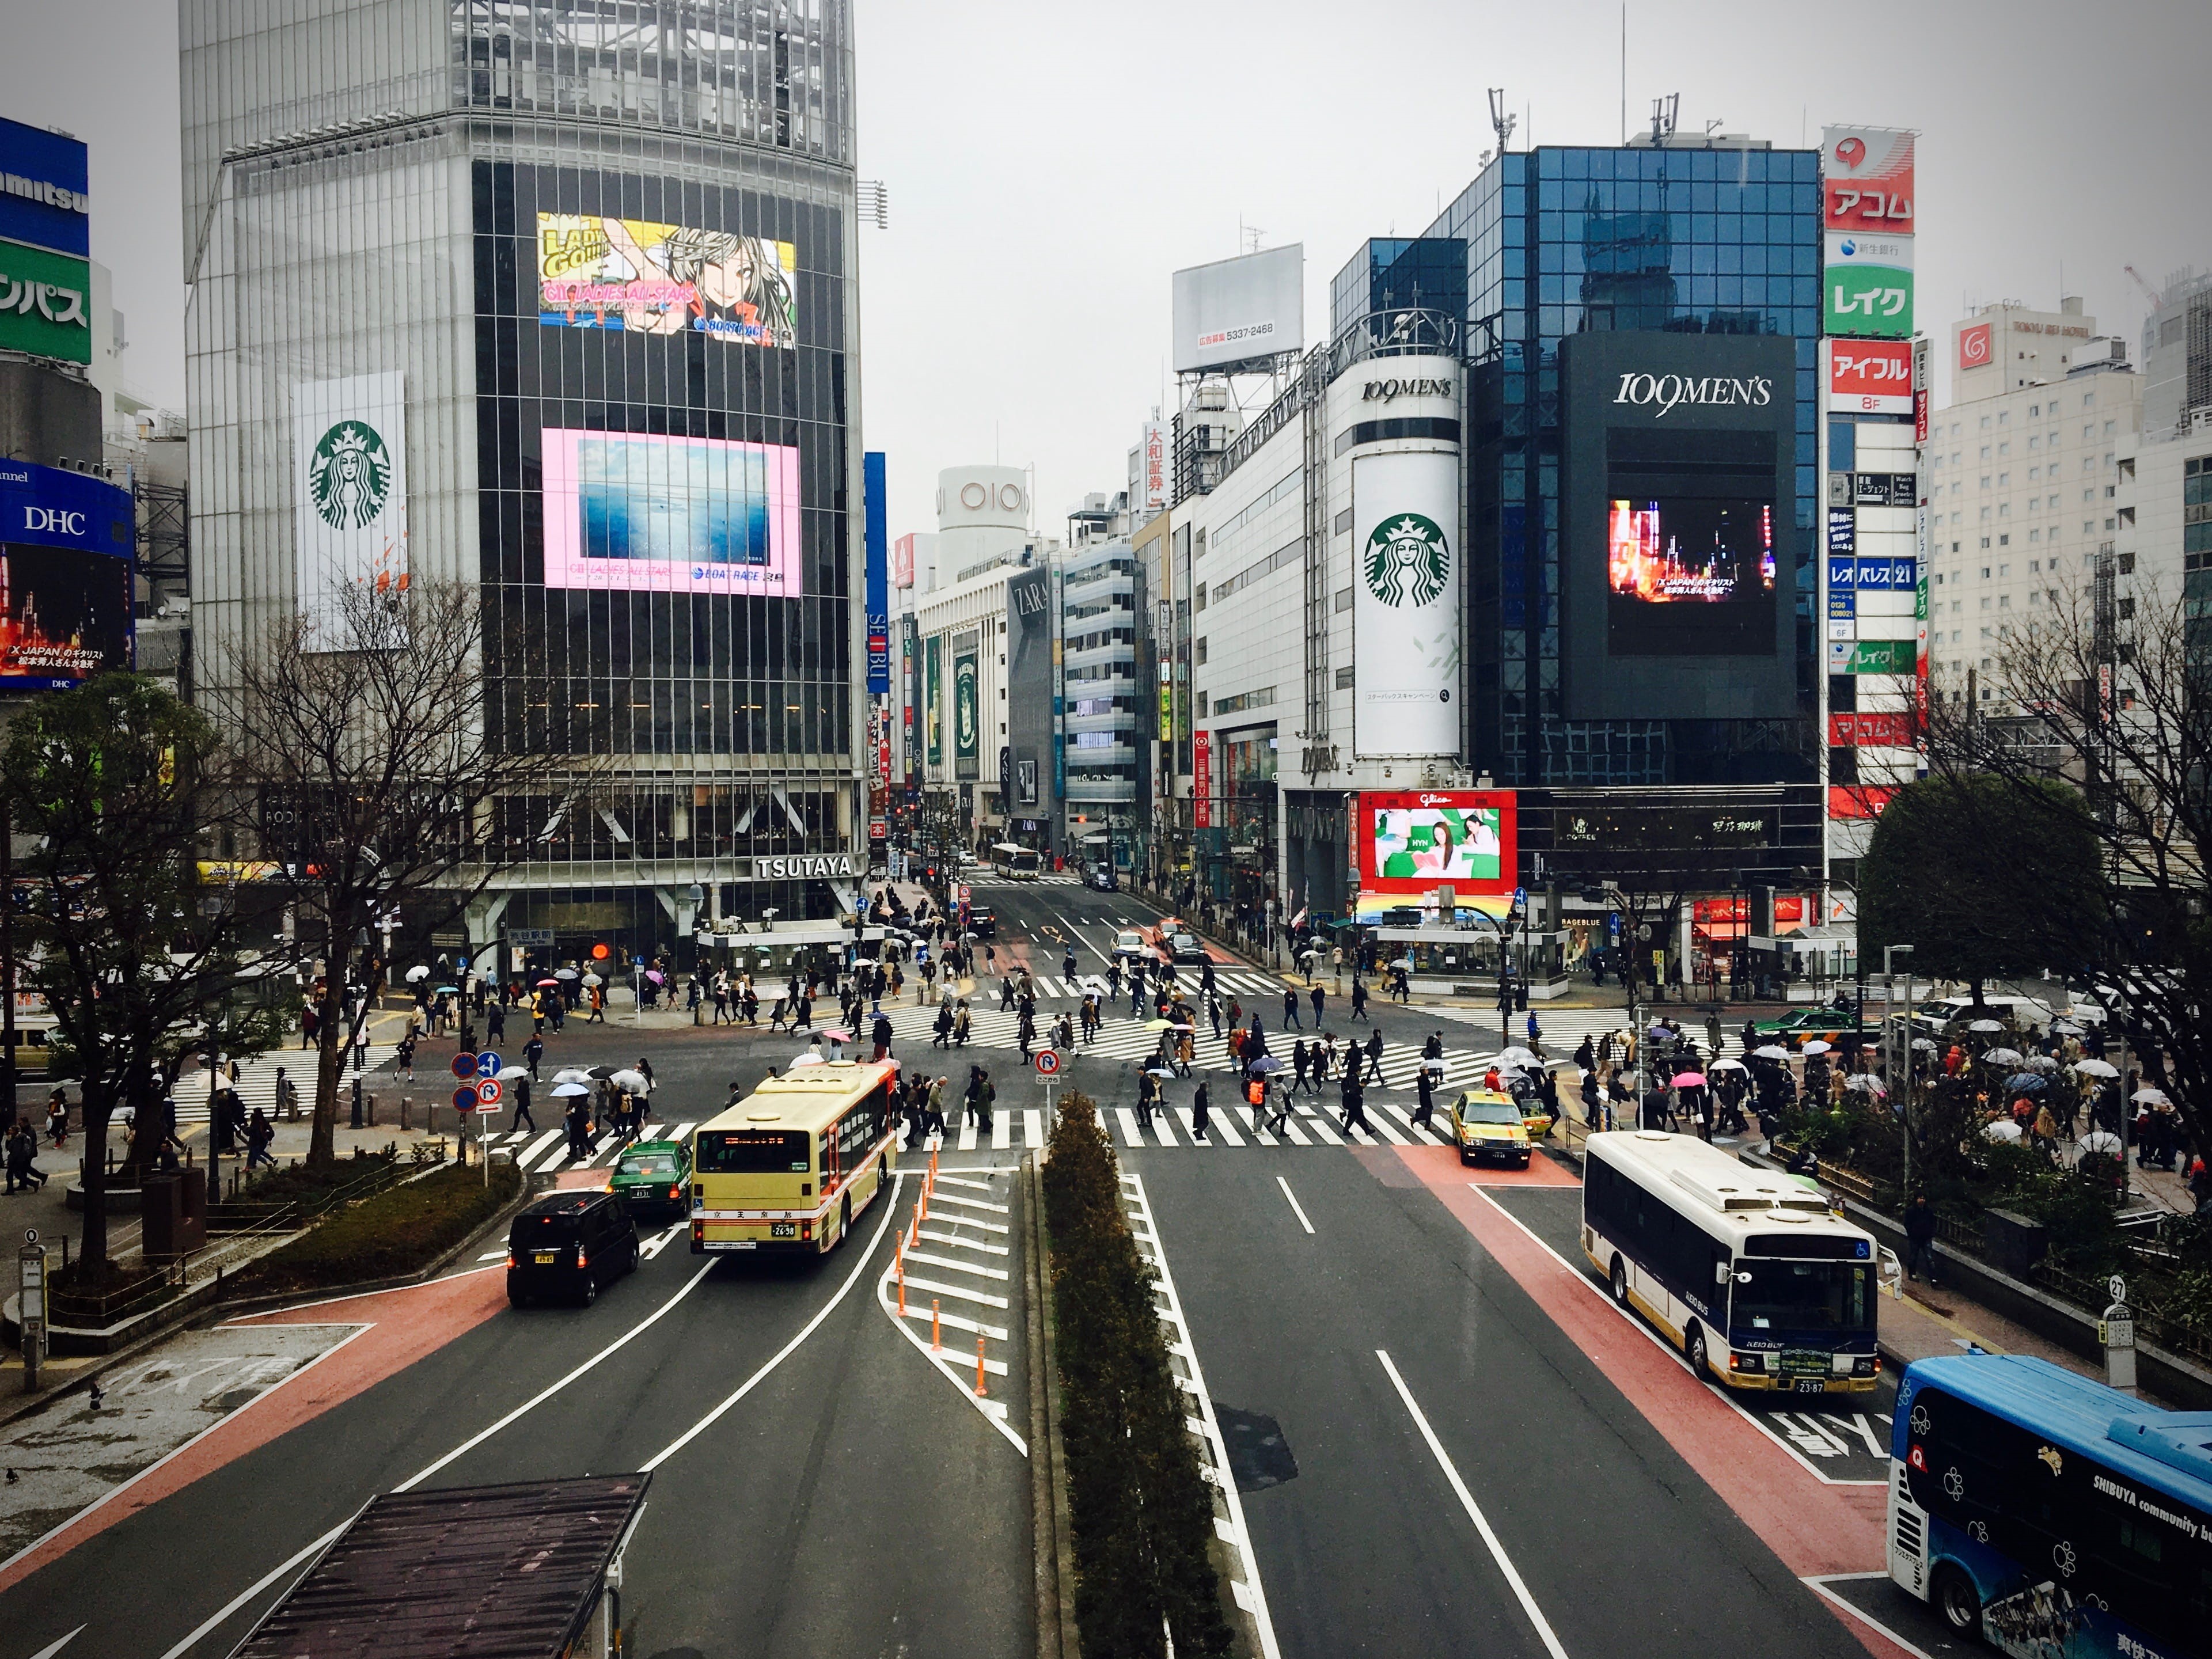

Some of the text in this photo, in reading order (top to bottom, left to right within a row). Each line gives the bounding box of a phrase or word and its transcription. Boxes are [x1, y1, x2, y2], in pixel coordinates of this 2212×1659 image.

[1834, 189, 1913, 218] アコム
[1859, 244, 1899, 256] 新生銀行
[1834, 286, 1906, 316] レイク
[1199, 324, 1273, 346] 広告募集 5337-2468
[1834, 356, 1909, 380] アイフル
[1862, 397, 1880, 409] 8F
[1148, 428, 1163, 491] 大和証券
[1858, 485, 1889, 493] エージェント
[24, 507, 85, 536] DHC
[1014, 583, 1047, 616] ZARA
[869, 614, 886, 677] SEIBU
[1858, 651, 1890, 664] レイク
[52, 680, 70, 688] DHC
[1420, 794, 1452, 807] Glico
[873, 825, 883, 835] 本
[1023, 820, 1036, 830] ZARA
[757, 857, 851, 878] TSUTAYA
[2111, 1280, 2123, 1298] 27
[1686, 1291, 1709, 1316] KEIO BUS
[2093, 1475, 2137, 1506] SHIBUYA
[2139, 1500, 2198, 1538] community
